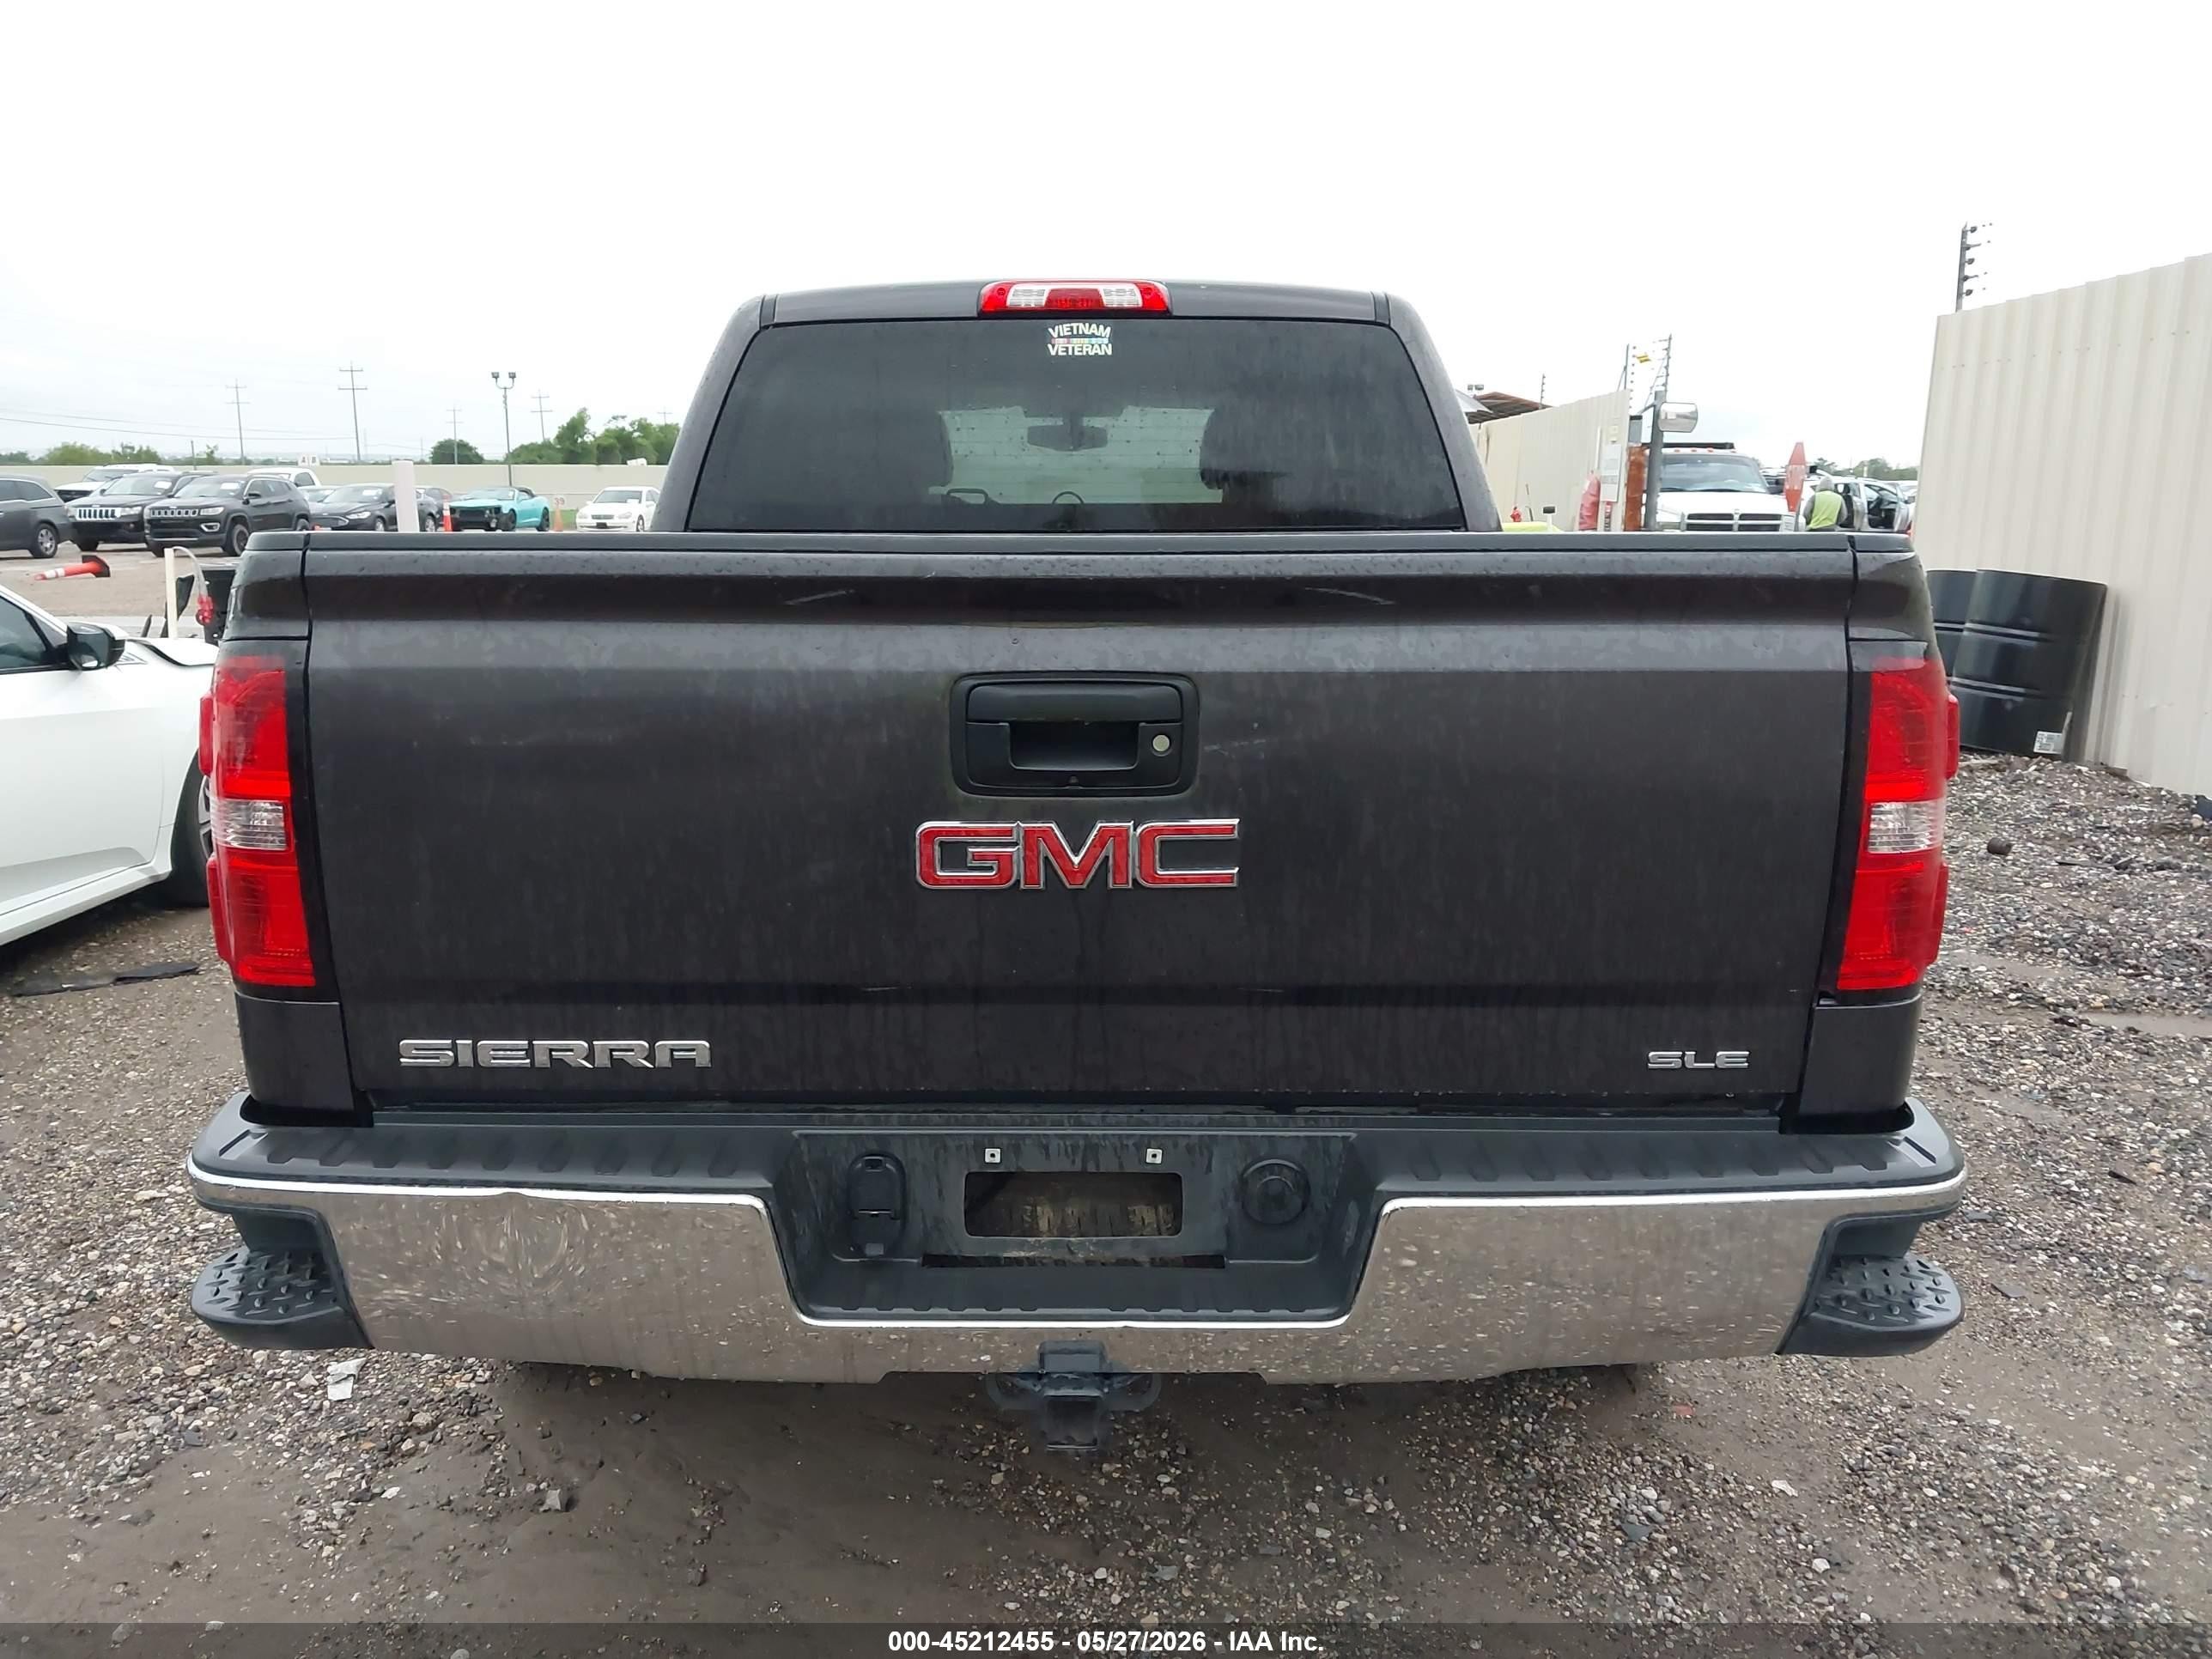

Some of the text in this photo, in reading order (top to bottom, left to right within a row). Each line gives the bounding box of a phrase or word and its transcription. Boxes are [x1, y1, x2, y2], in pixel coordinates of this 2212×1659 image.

[1048, 322, 1111, 337] VIETNAM
[1047, 343, 1113, 356] VETERAN
[915, 818, 1240, 890] GMC
[399, 1039, 712, 1068] SIERRA
[1648, 1050, 1750, 1069] SLE
